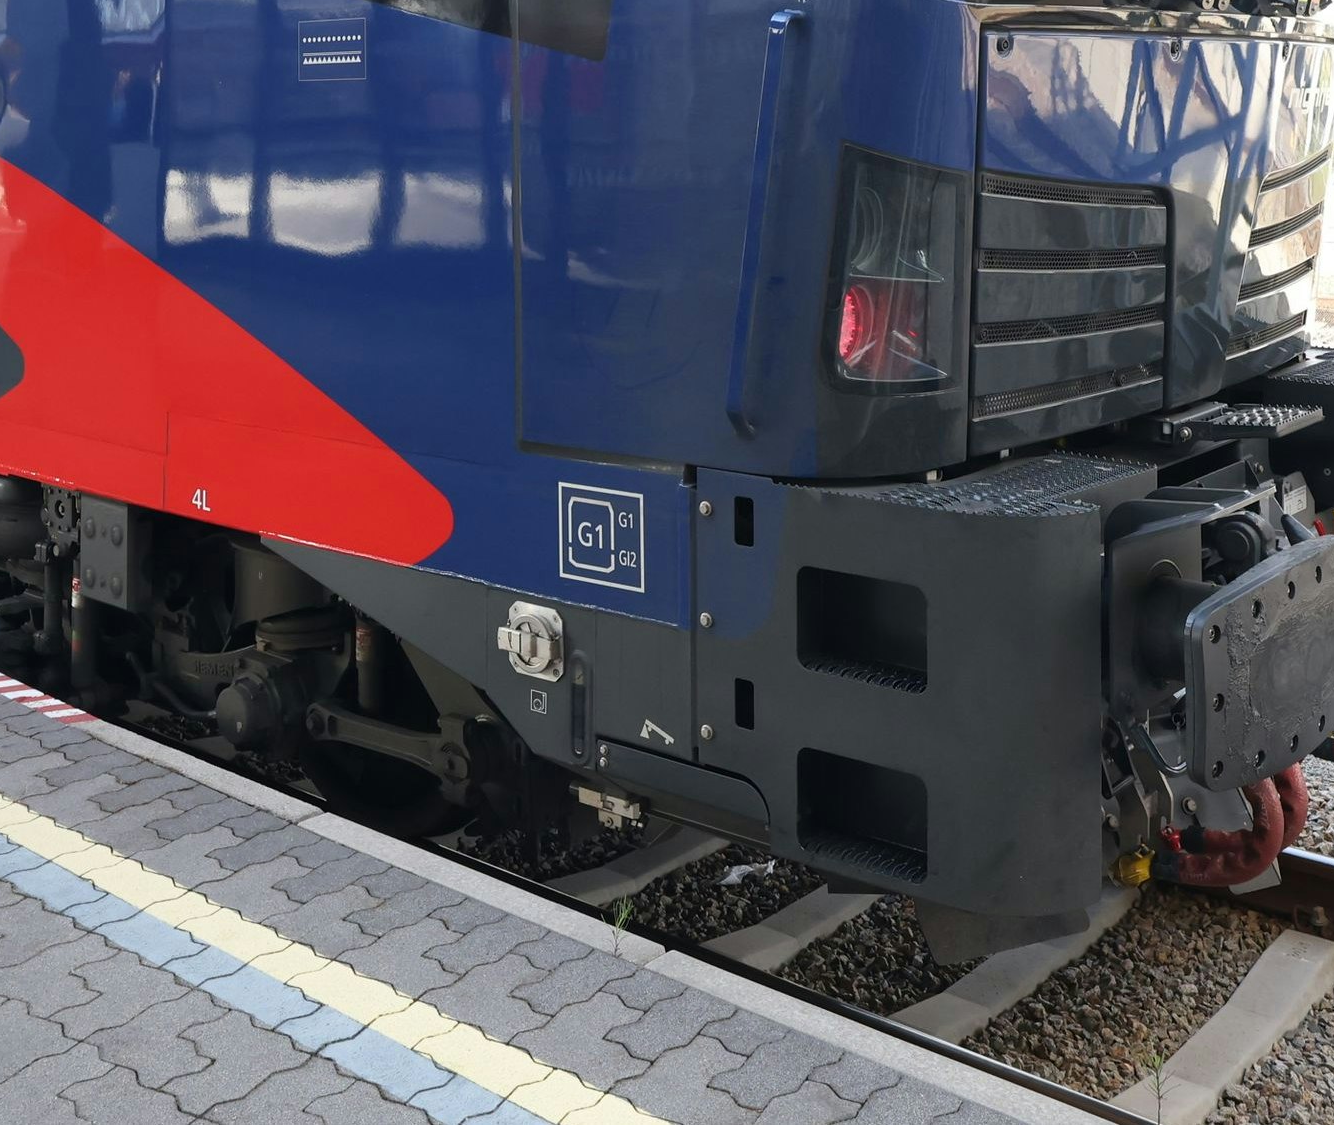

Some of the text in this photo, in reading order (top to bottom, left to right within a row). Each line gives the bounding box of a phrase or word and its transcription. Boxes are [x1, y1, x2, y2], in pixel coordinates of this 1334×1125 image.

[192, 488, 211, 512] 4L
[618, 512, 633, 529] G1
[578, 521, 603, 549] G1
